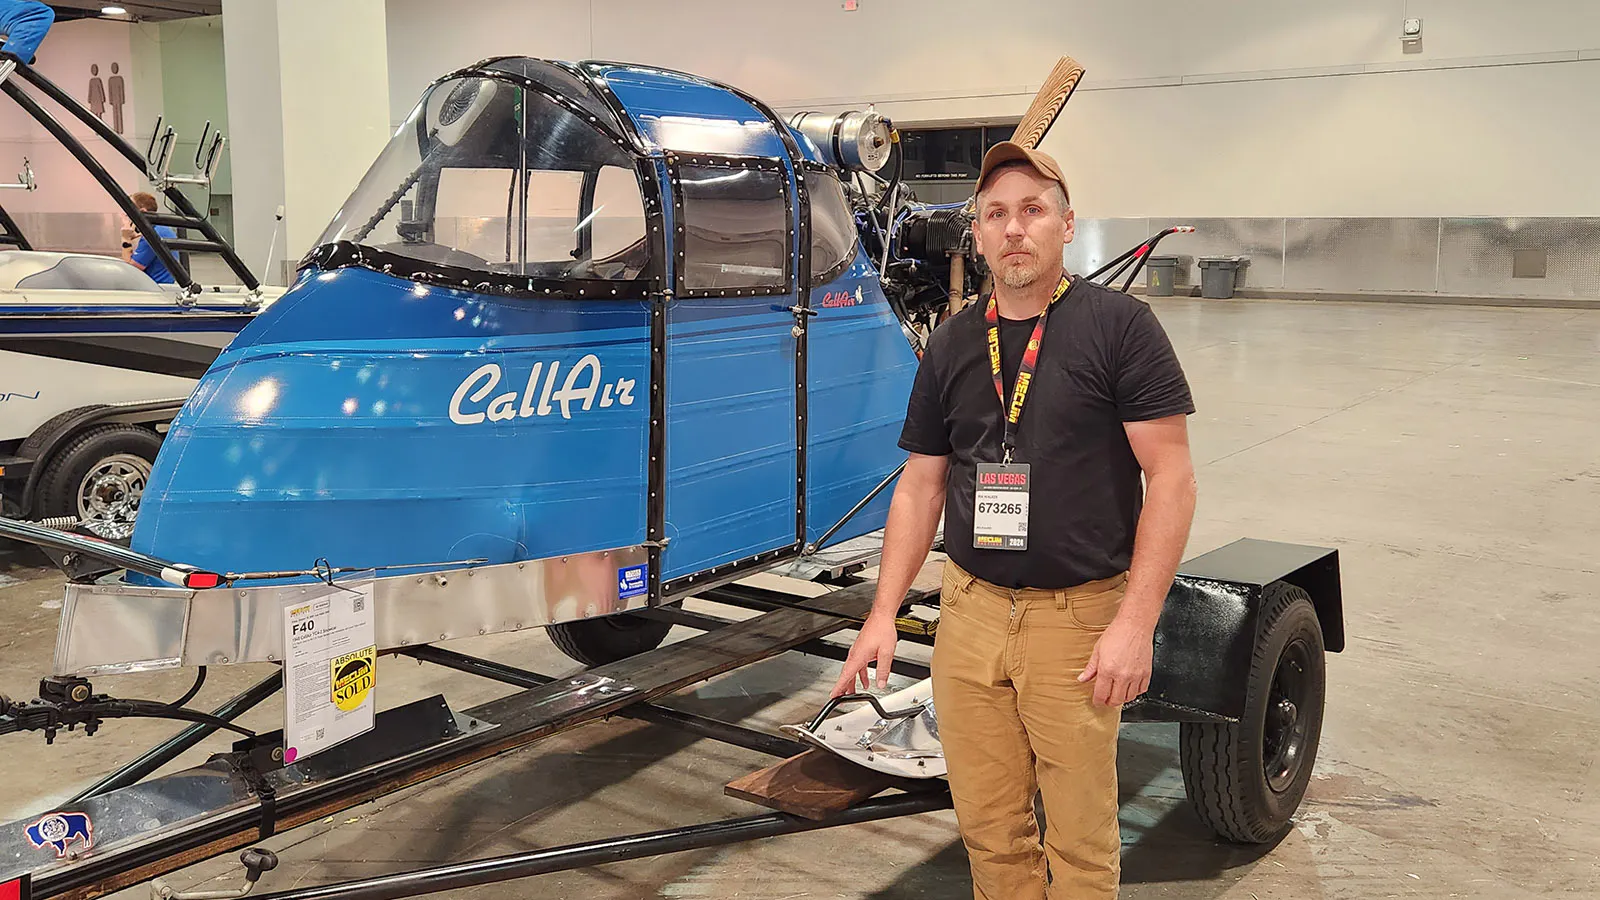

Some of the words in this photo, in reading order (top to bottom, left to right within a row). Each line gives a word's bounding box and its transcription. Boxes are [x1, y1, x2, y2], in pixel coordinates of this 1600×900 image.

[822, 290, 856, 308] CallAir
[987, 326, 1001, 375] MECUM
[448, 354, 636, 425] CallAir
[1008, 371, 1032, 424] MECUM
[980, 472, 996, 485] LAS
[998, 473, 1026, 485] VEGAS
[978, 502, 1022, 515] 673265
[1009, 538, 1024, 546] 2024
[292, 620, 315, 636] F40
[335, 647, 373, 666] ABSOLUTE
[336, 664, 368, 688] MECUM
[336, 676, 371, 705] SOLD
